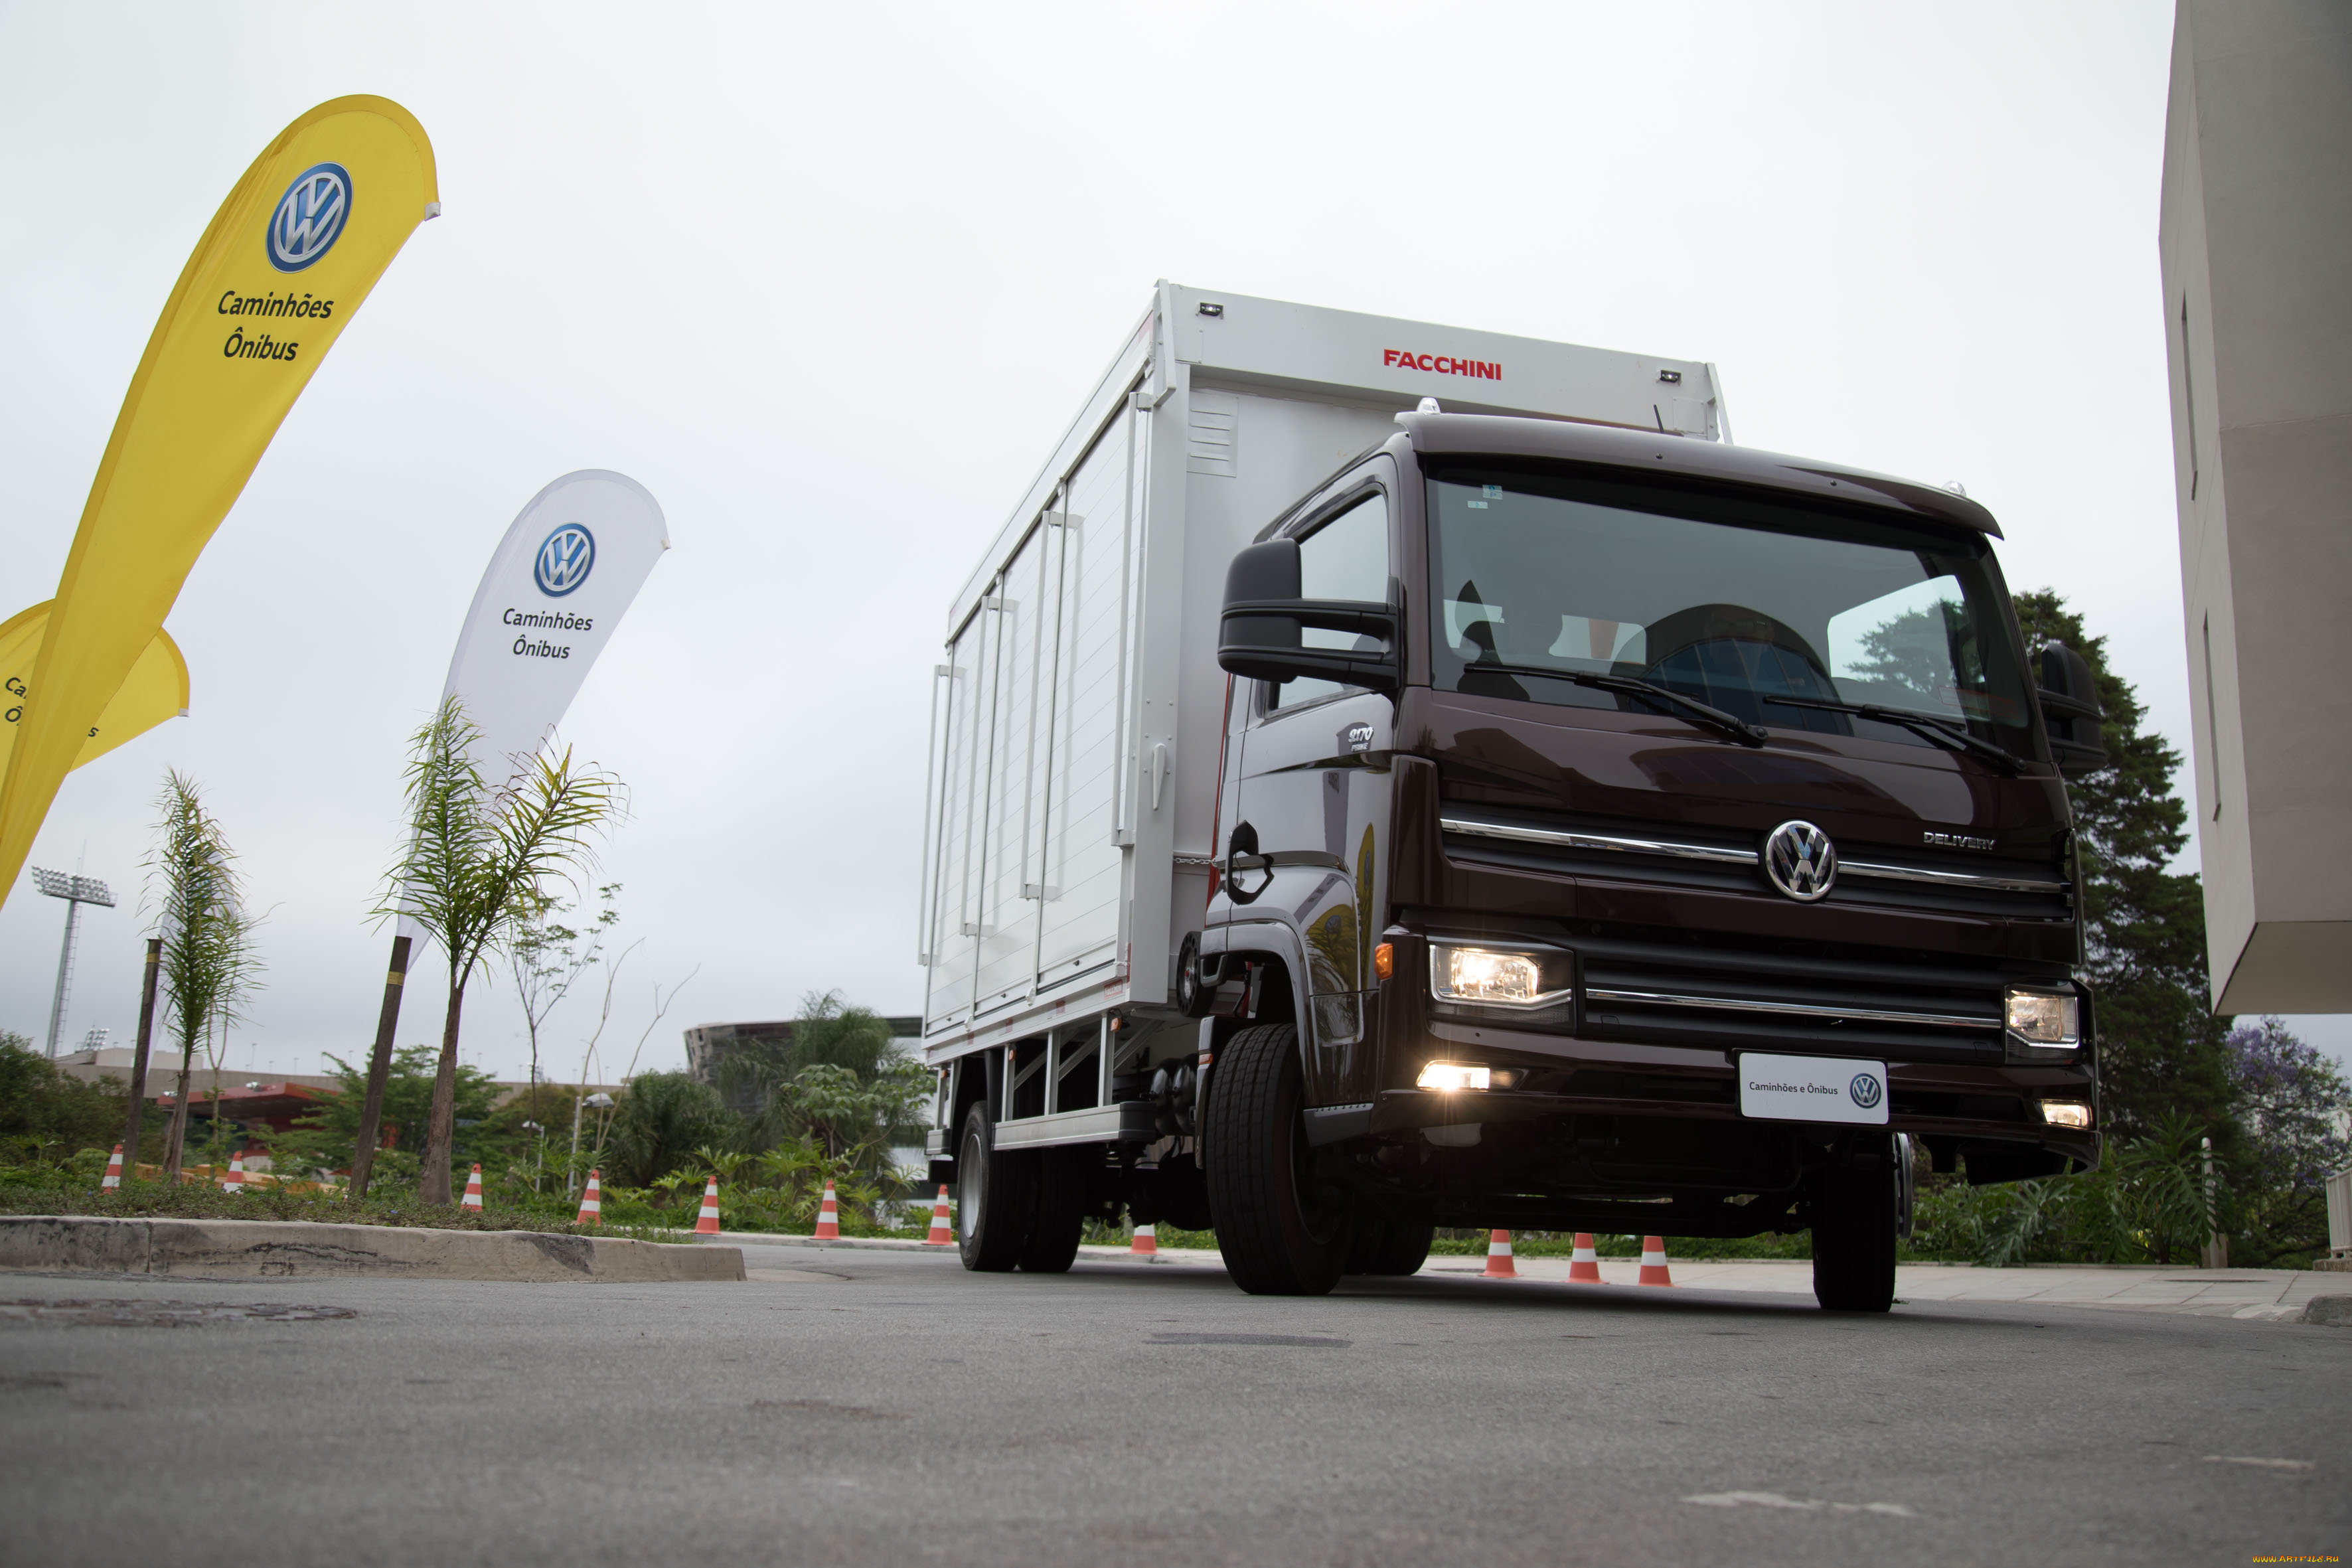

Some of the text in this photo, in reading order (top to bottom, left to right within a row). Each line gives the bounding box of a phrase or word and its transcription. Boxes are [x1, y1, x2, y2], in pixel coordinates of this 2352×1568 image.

[218, 290, 335, 319] Caminhões
[224, 326, 299, 362] Ônibus
[1383, 349, 1502, 380] FACCHINI
[503, 607, 593, 631] Caminhões
[512, 634, 571, 659] Ônibus
[1348, 726, 1374, 742] 9170
[1923, 831, 1996, 850] DELIVERY
[1749, 1081, 1798, 1093] Caminhões
[1807, 1082, 1838, 1095] Ônibus
